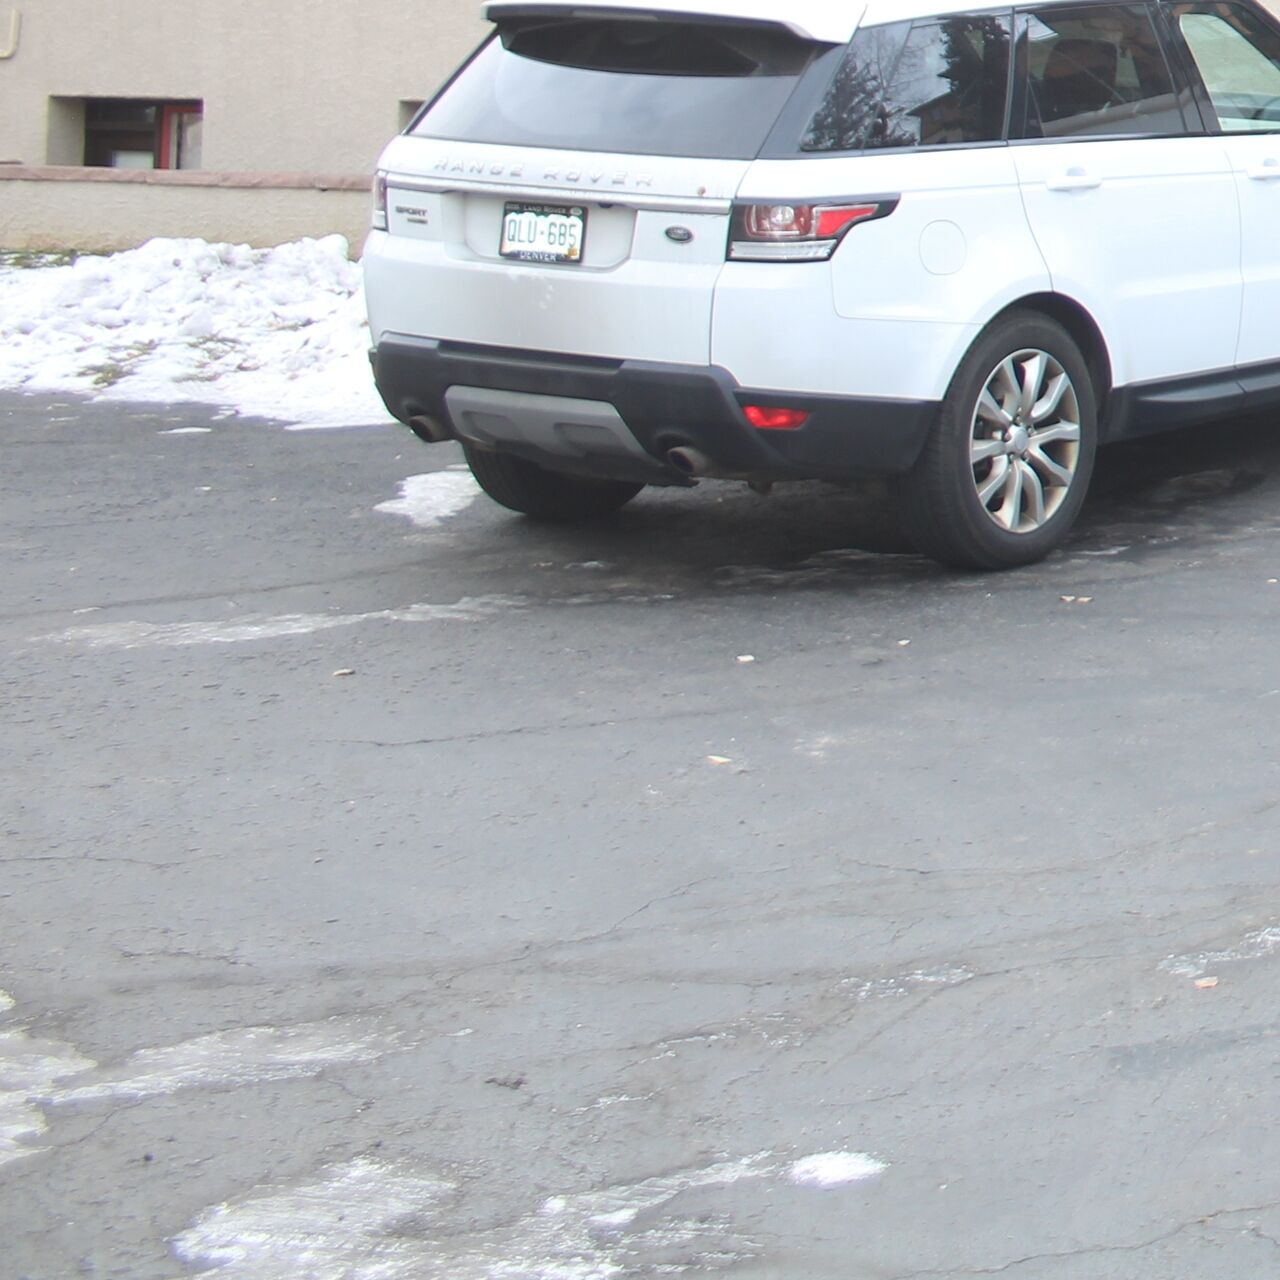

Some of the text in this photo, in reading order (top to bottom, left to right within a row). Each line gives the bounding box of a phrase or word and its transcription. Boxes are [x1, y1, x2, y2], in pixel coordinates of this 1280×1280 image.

[433, 157, 655, 187] RANGE ROVER
[519, 251, 557, 262] DENVER
